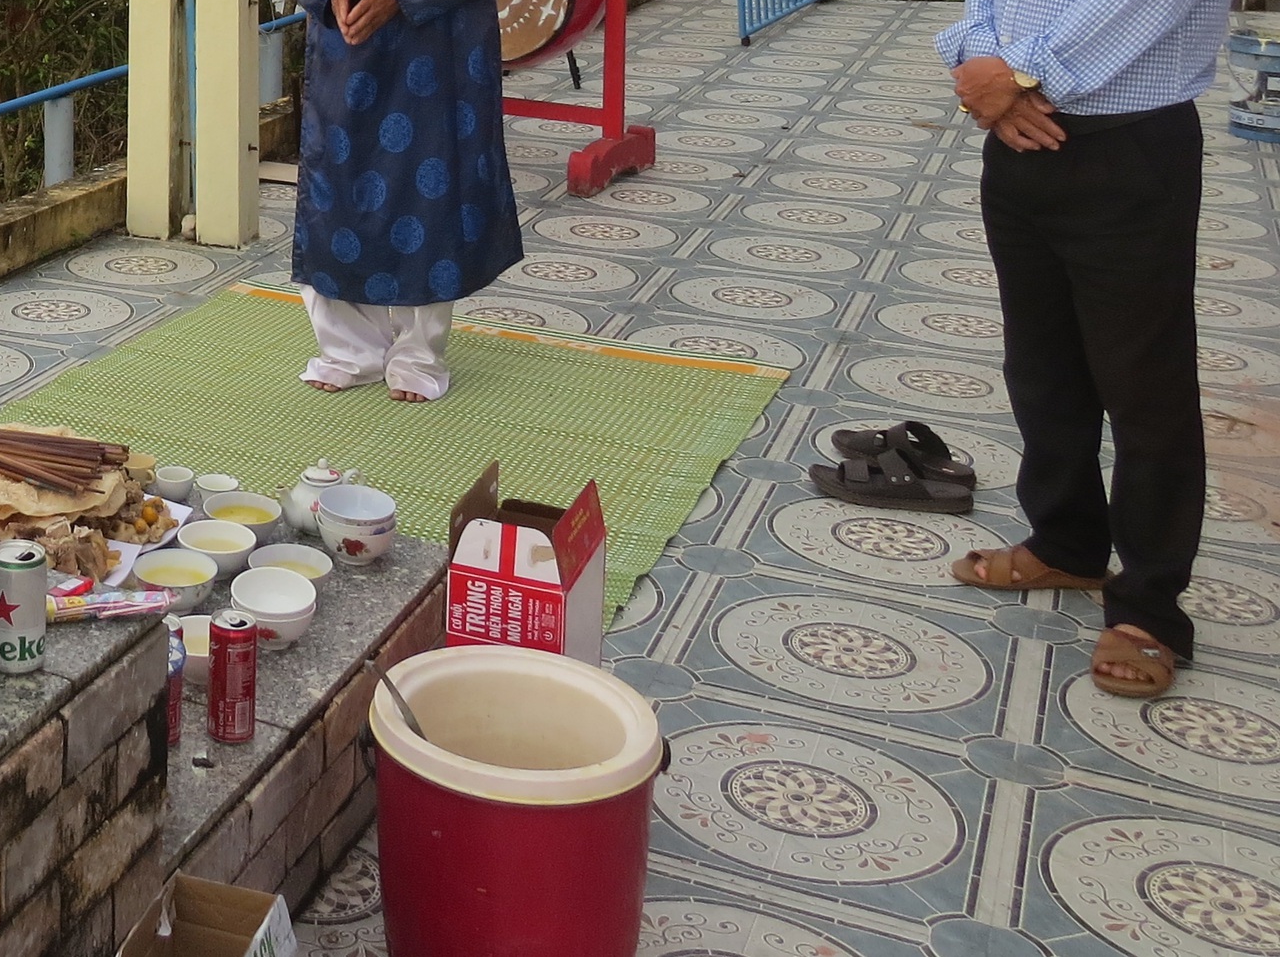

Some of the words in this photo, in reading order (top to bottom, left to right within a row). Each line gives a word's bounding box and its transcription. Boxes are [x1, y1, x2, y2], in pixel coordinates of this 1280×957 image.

[451, 603, 465, 618] HỘI
[463, 580, 487, 633] TRÚNG
[489, 585, 504, 614] THOẠI
[505, 588, 523, 619] NGÀY
[486, 615, 502, 639] ĐIỆN
